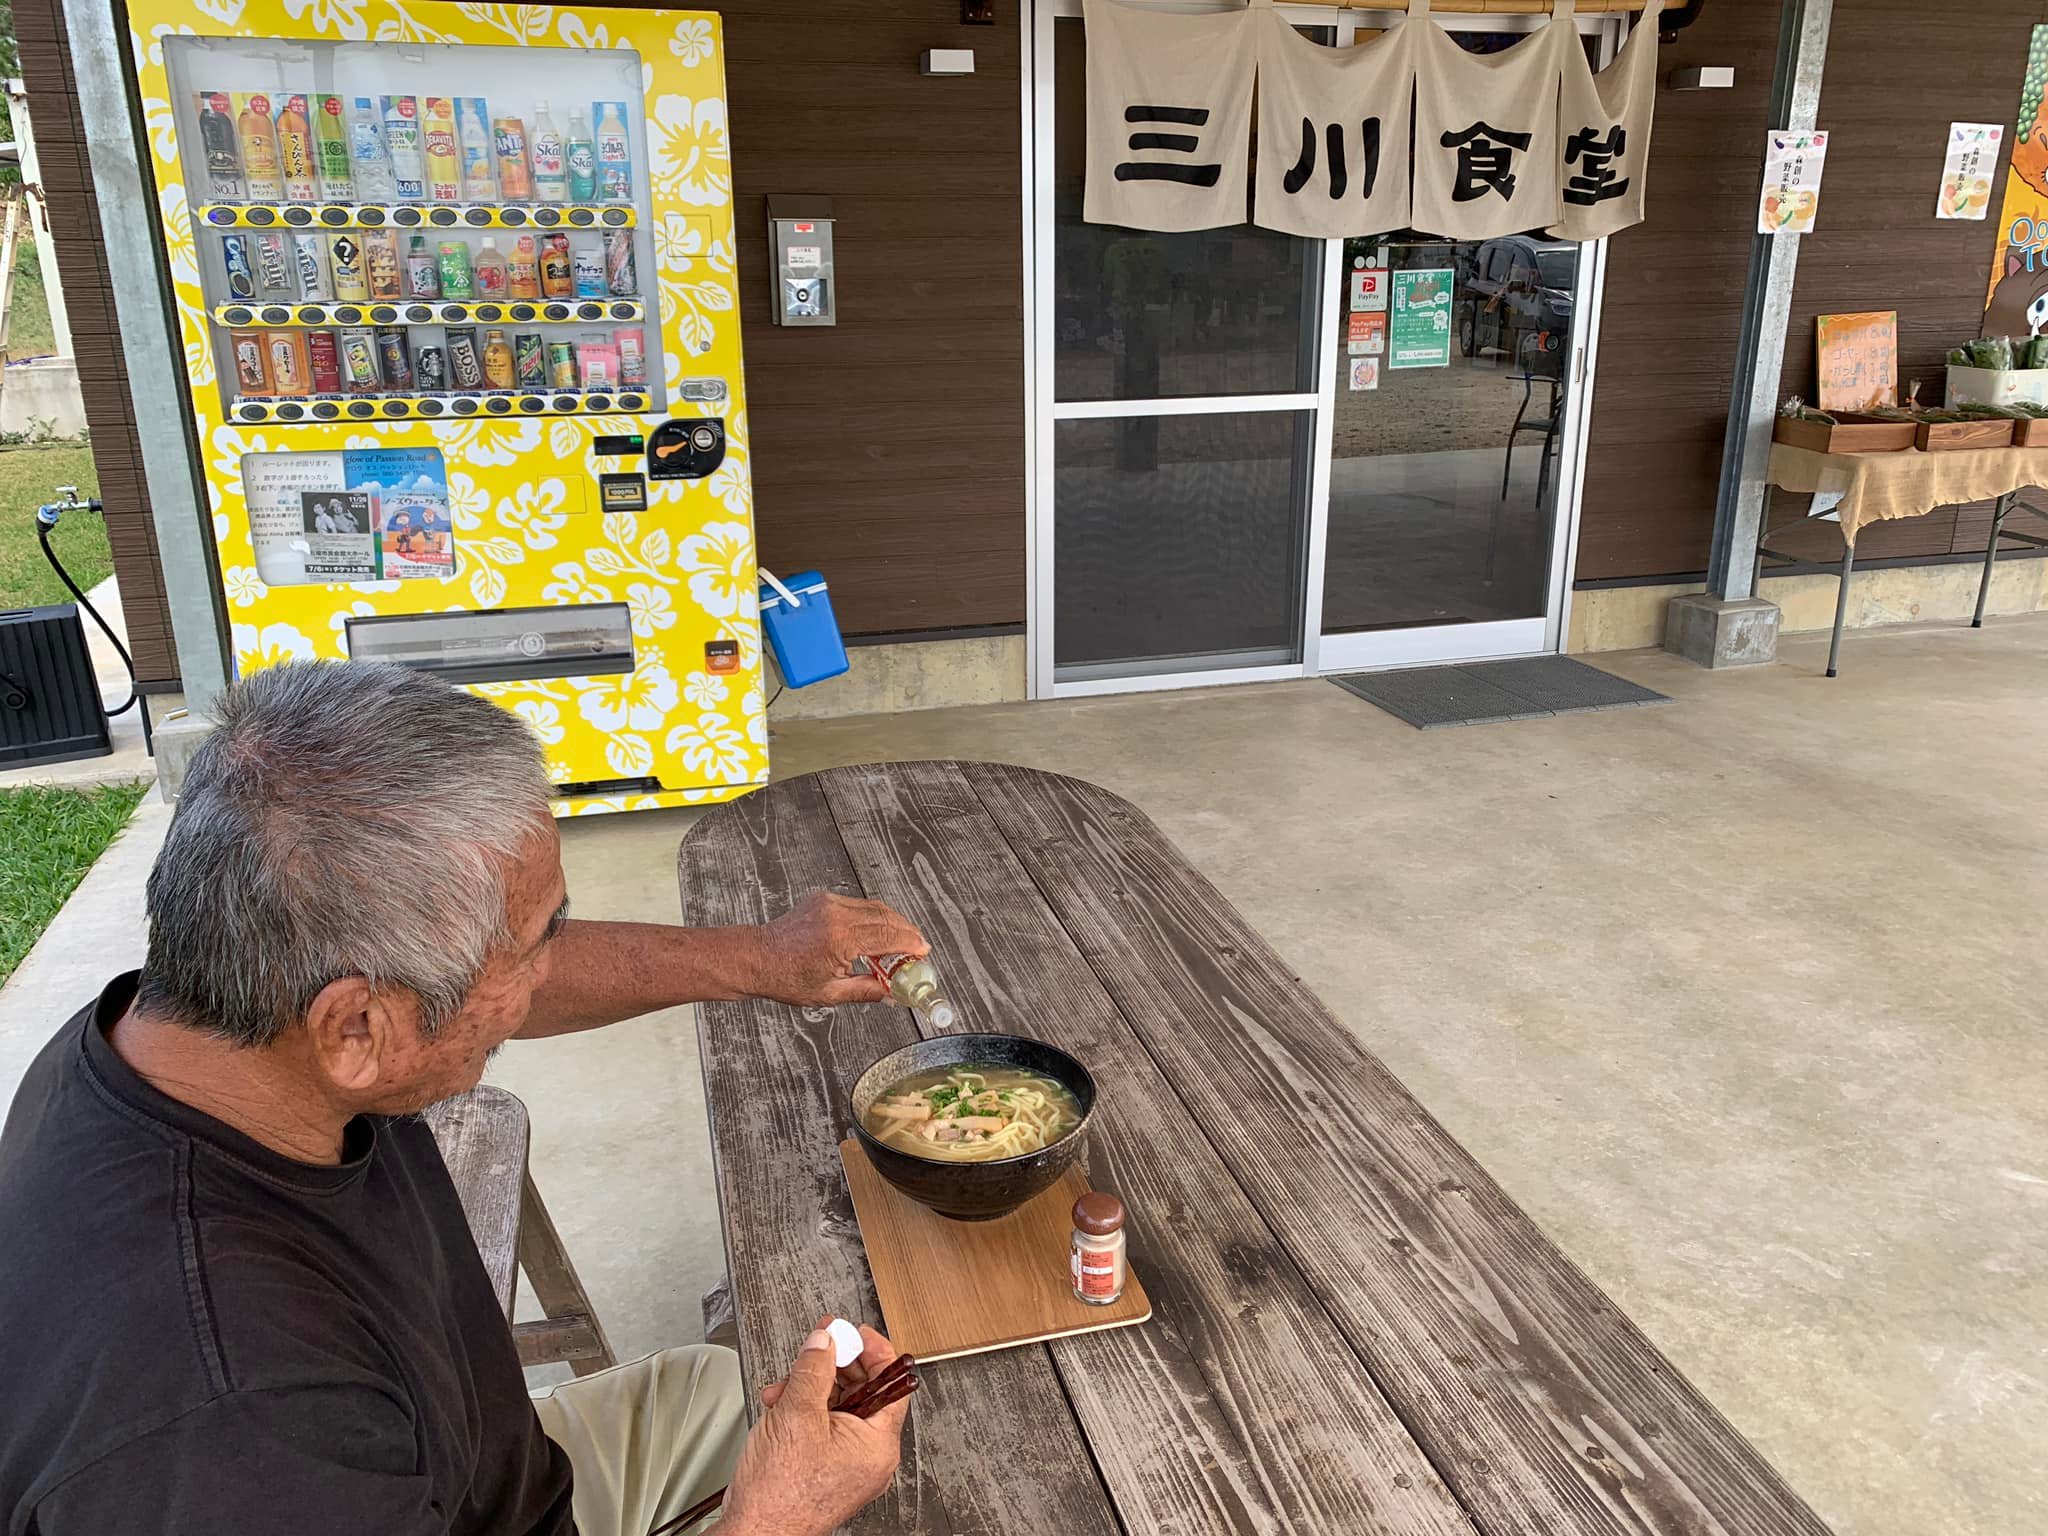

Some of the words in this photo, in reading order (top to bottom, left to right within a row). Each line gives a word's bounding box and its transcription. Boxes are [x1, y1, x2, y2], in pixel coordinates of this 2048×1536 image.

[290, 134, 307, 177] さんぴん茶
[1114, 105, 1630, 206] 三川食堂
[214, 181, 240, 195] NO.1
[399, 182, 418, 192] 600
[457, 344, 480, 384] BOSS
